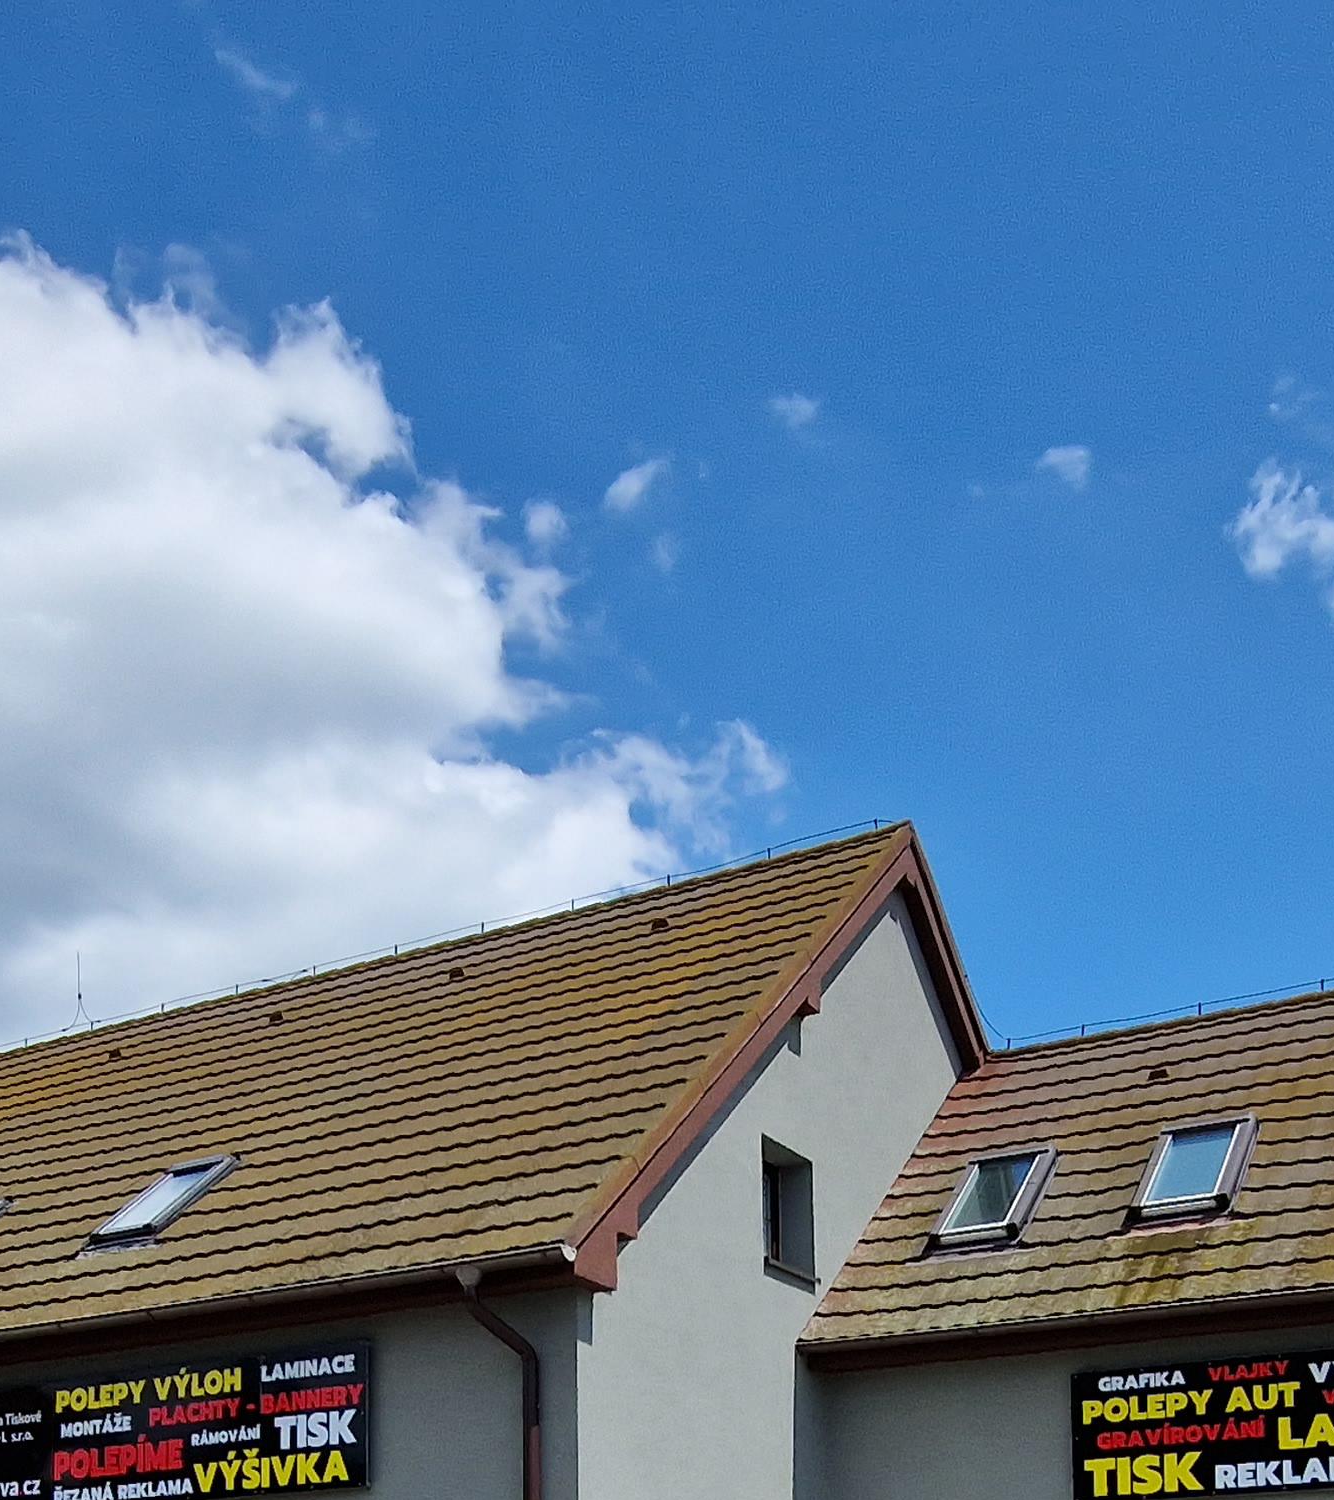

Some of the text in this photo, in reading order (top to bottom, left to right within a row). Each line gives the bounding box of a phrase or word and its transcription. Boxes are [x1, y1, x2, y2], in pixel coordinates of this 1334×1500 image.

[260, 1354, 356, 1382] LAMINACE
[1098, 1370, 1186, 1392] GRAFIKA
[1207, 1360, 1289, 1381] VLAJKY
[55, 1366, 242, 1414] POLEPY VÝLOH
[149, 1397, 241, 1427] PLACHTY
[260, 1383, 364, 1414] BANNERY
[1082, 1381, 1301, 1425] POLEPY AUT
[5, 1410, 42, 1426] Tiskové
[60, 1412, 132, 1439] MONTÁŽE
[274, 1408, 357, 1450] TISK
[1097, 1414, 1266, 1450] GRAVÍROVÁNÍ
[11, 1431, 34, 1442] s.r.o.
[191, 1423, 261, 1447] RÁMOVÁNÍ
[53, 1433, 184, 1481] POLEPÍME
[193, 1448, 349, 1493] VÝŠIVKA
[117, 1478, 194, 1500] REKLAMA
[1083, 1451, 1205, 1497] TISK
